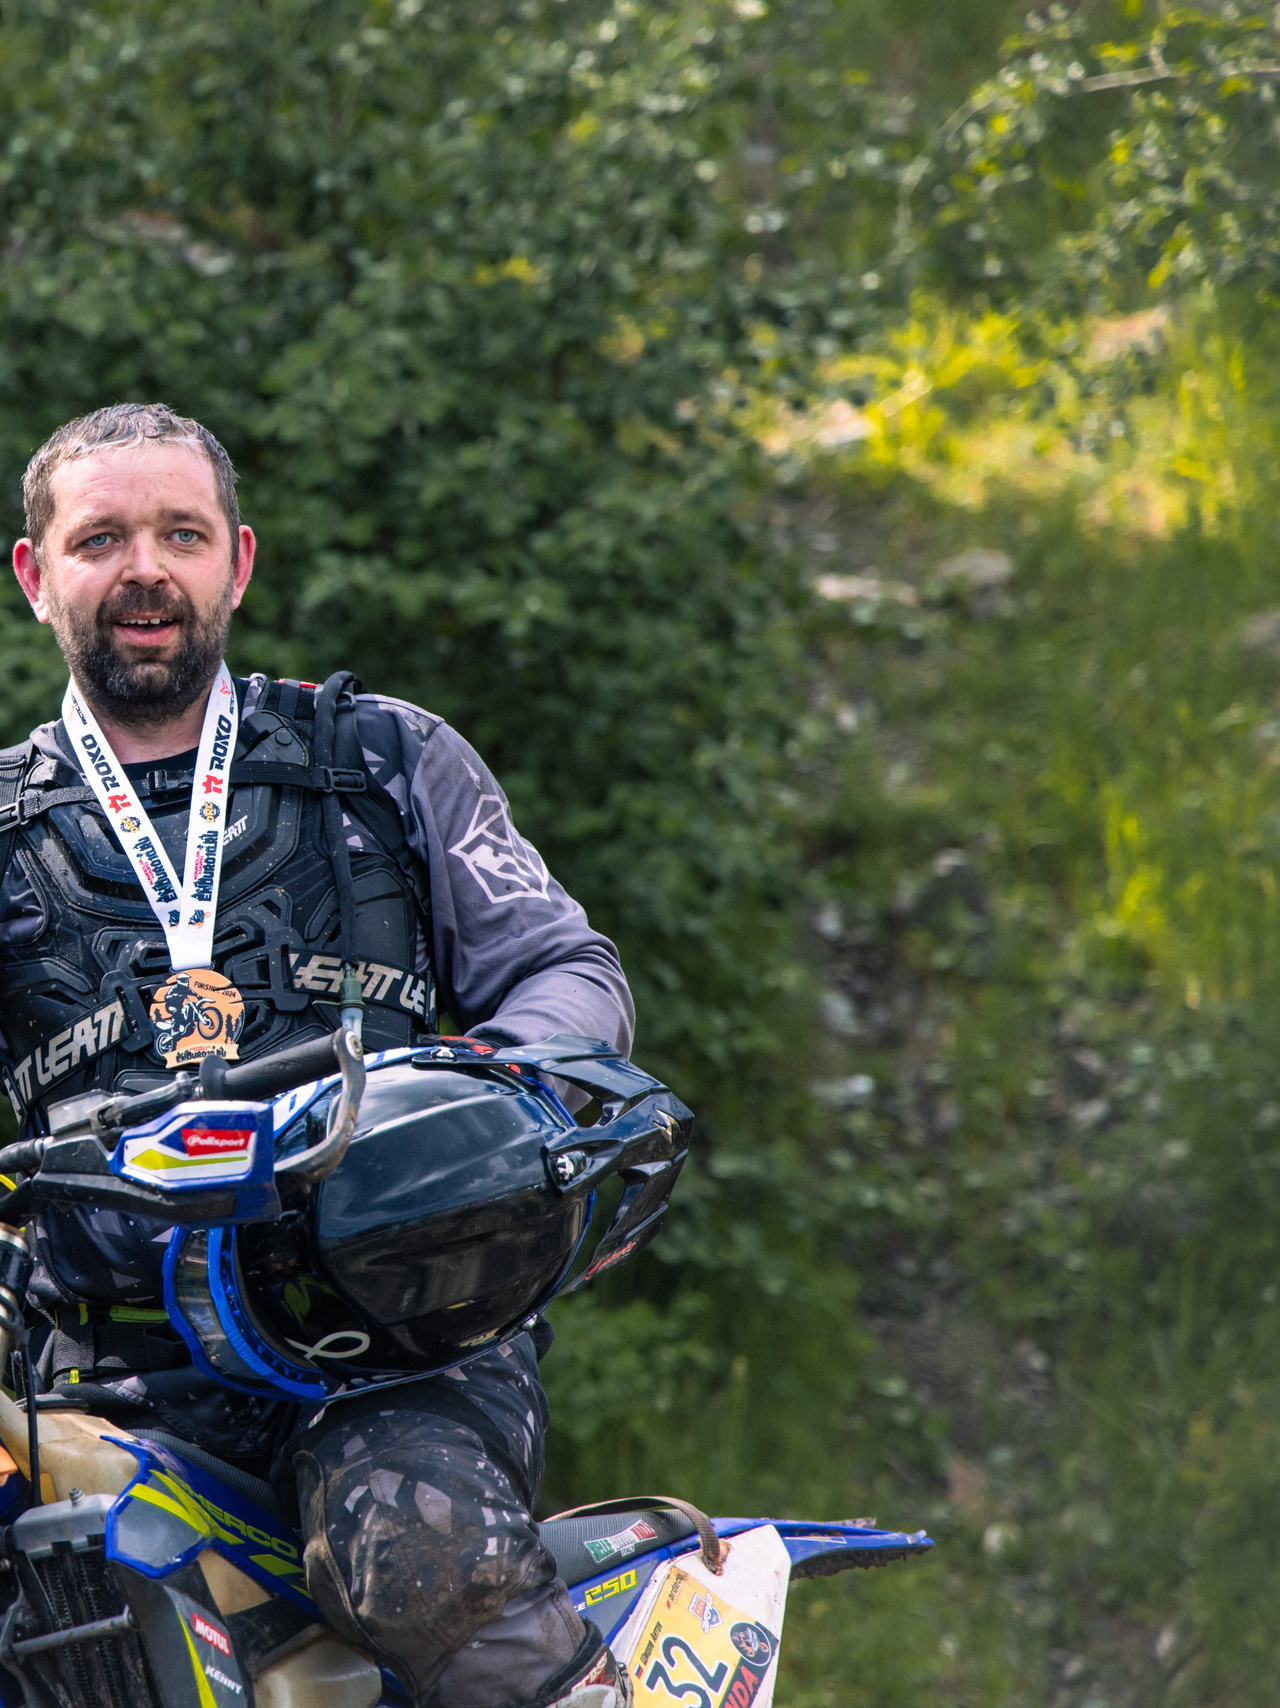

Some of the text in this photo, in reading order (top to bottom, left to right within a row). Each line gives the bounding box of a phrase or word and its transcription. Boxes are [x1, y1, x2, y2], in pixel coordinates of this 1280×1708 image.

[209, 714, 232, 771] ROKO
[81, 733, 121, 792] ROKO
[203, 801, 216, 823] DRC
[222, 814, 248, 846] EATT
[222, 989, 237, 998] 2024
[35, 1000, 124, 1086] LEATT
[187, 1134, 245, 1147] Polisport
[585, 1569, 637, 1607] 250
[195, 1618, 229, 1655] MOTUL
[205, 1664, 242, 1694] KENNY
[646, 1636, 728, 1708] 32
[723, 1665, 759, 1708] NDA
